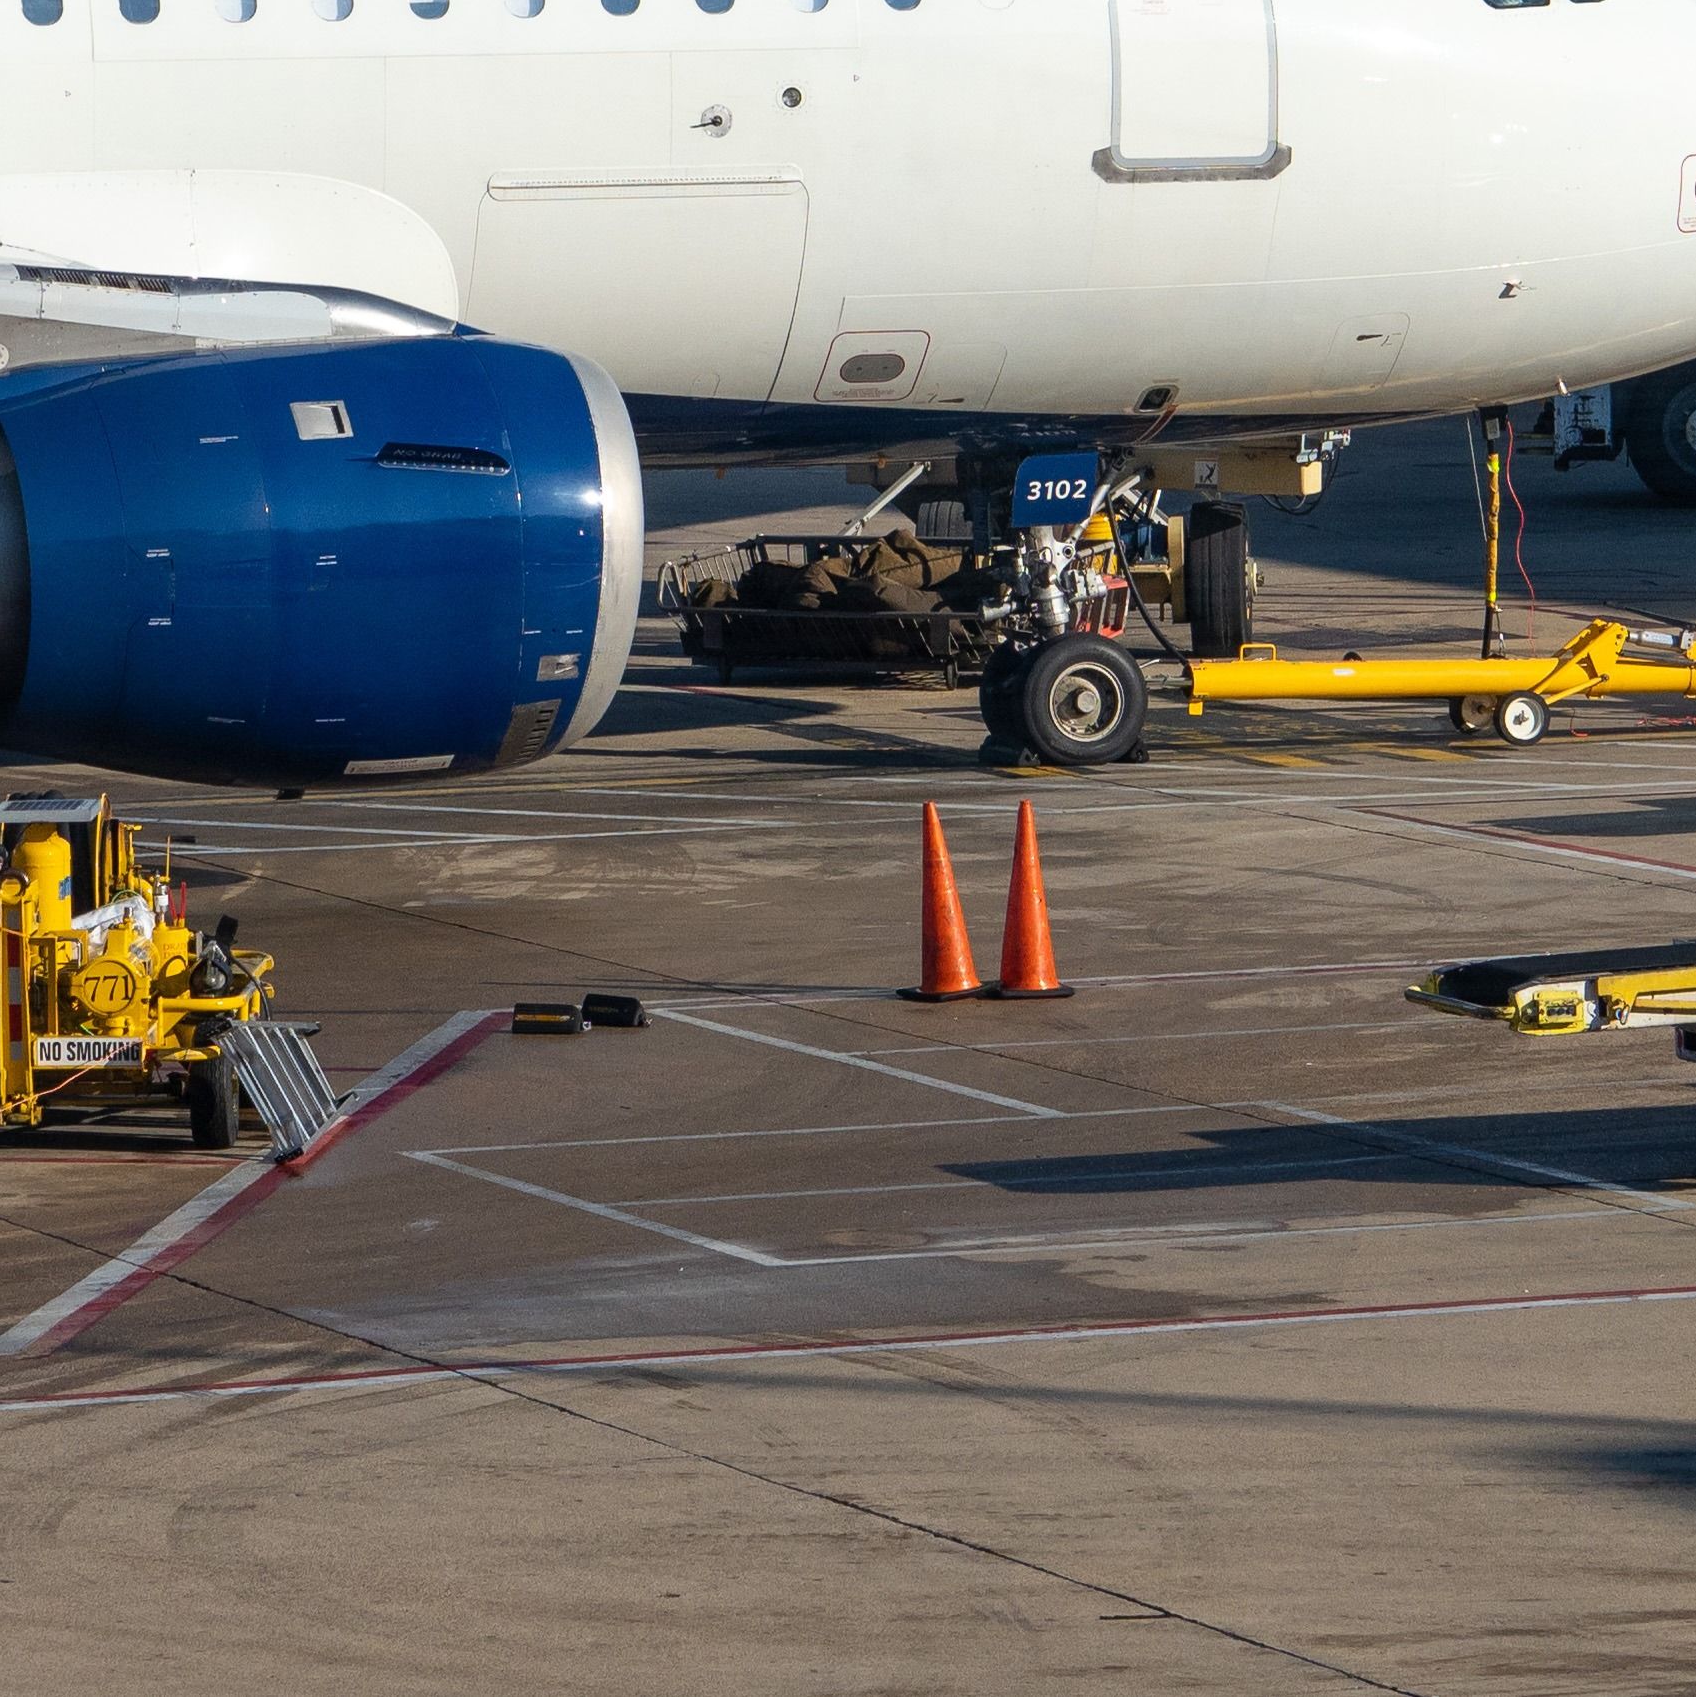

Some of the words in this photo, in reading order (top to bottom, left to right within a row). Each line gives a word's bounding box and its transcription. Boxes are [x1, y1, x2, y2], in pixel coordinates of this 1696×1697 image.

[1027, 479, 1087, 501] 3102
[83, 975, 132, 1003] 771
[39, 1041, 62, 1062] NO
[66, 1040, 140, 1062] SMOKING
